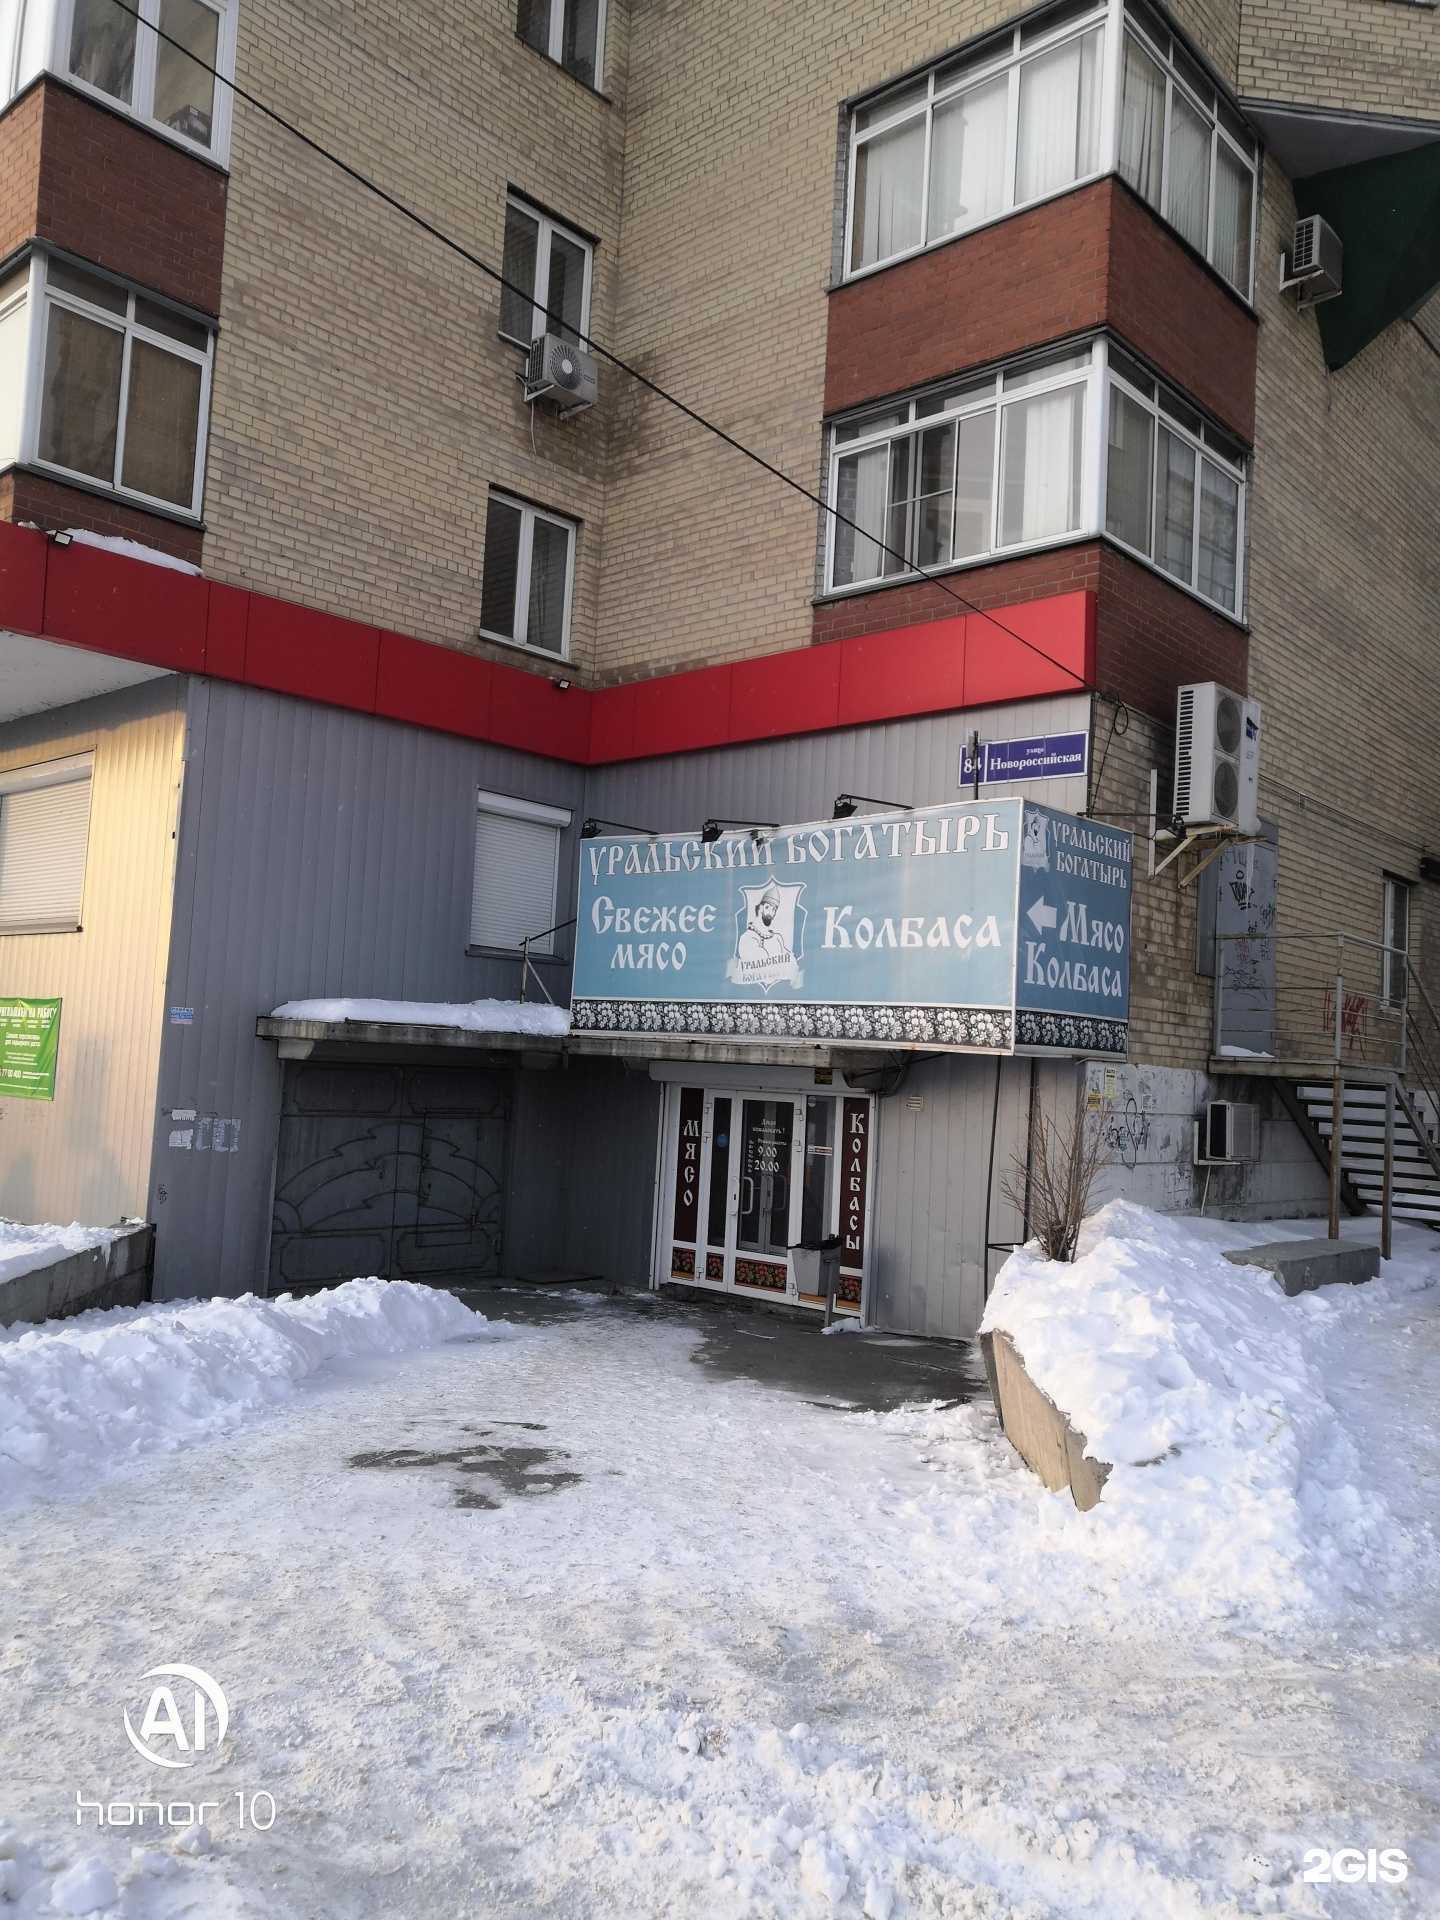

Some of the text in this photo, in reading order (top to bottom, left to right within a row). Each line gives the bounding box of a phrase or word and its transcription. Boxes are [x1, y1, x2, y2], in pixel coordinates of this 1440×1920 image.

[990, 752, 1082, 771] Новороссийская
[589, 813, 1009, 886] УРАЛЬСКИЙ БОГАТЫРЬ
[1052, 819, 1132, 863] УРАЛЬСКИЙ
[1055, 850, 1128, 889] БОГАТЫРЬ
[754, 1160, 779, 1173] 20.00
